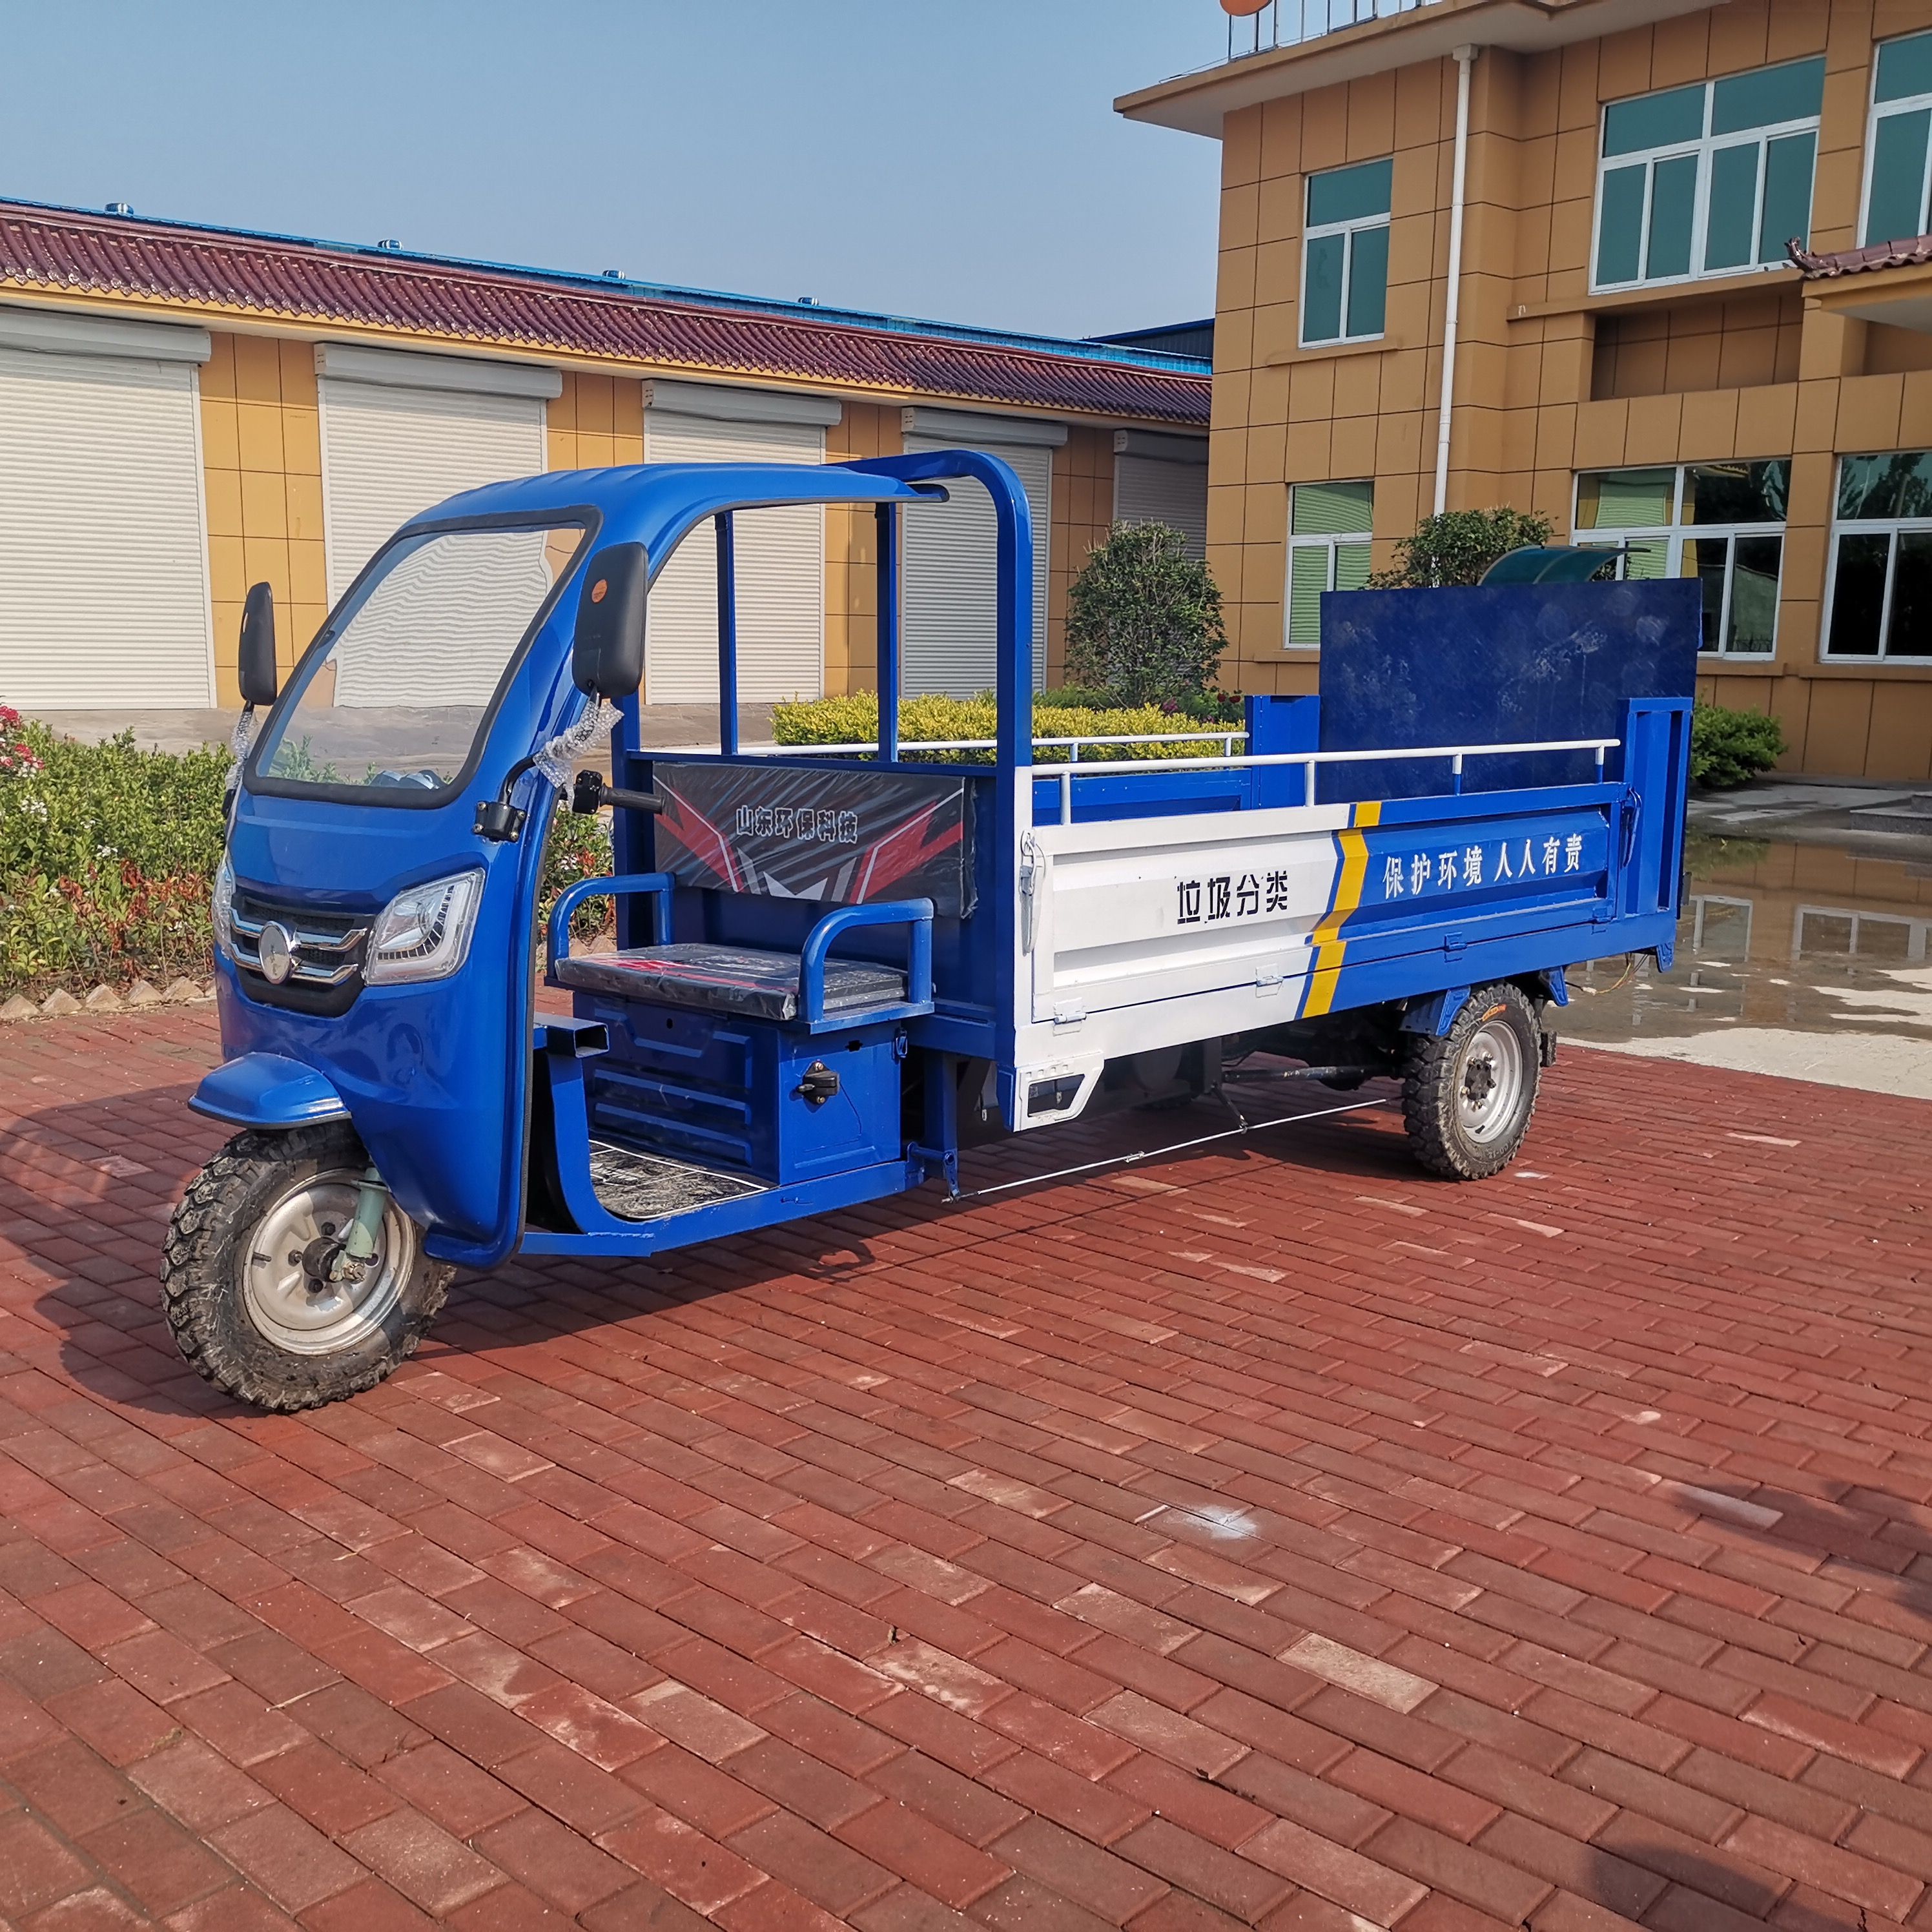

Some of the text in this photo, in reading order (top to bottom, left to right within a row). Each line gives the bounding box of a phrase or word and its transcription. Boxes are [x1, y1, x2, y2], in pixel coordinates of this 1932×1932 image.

[736, 805, 858, 843] 山东环保科技
[1177, 870, 1288, 924] 垃圾分类
